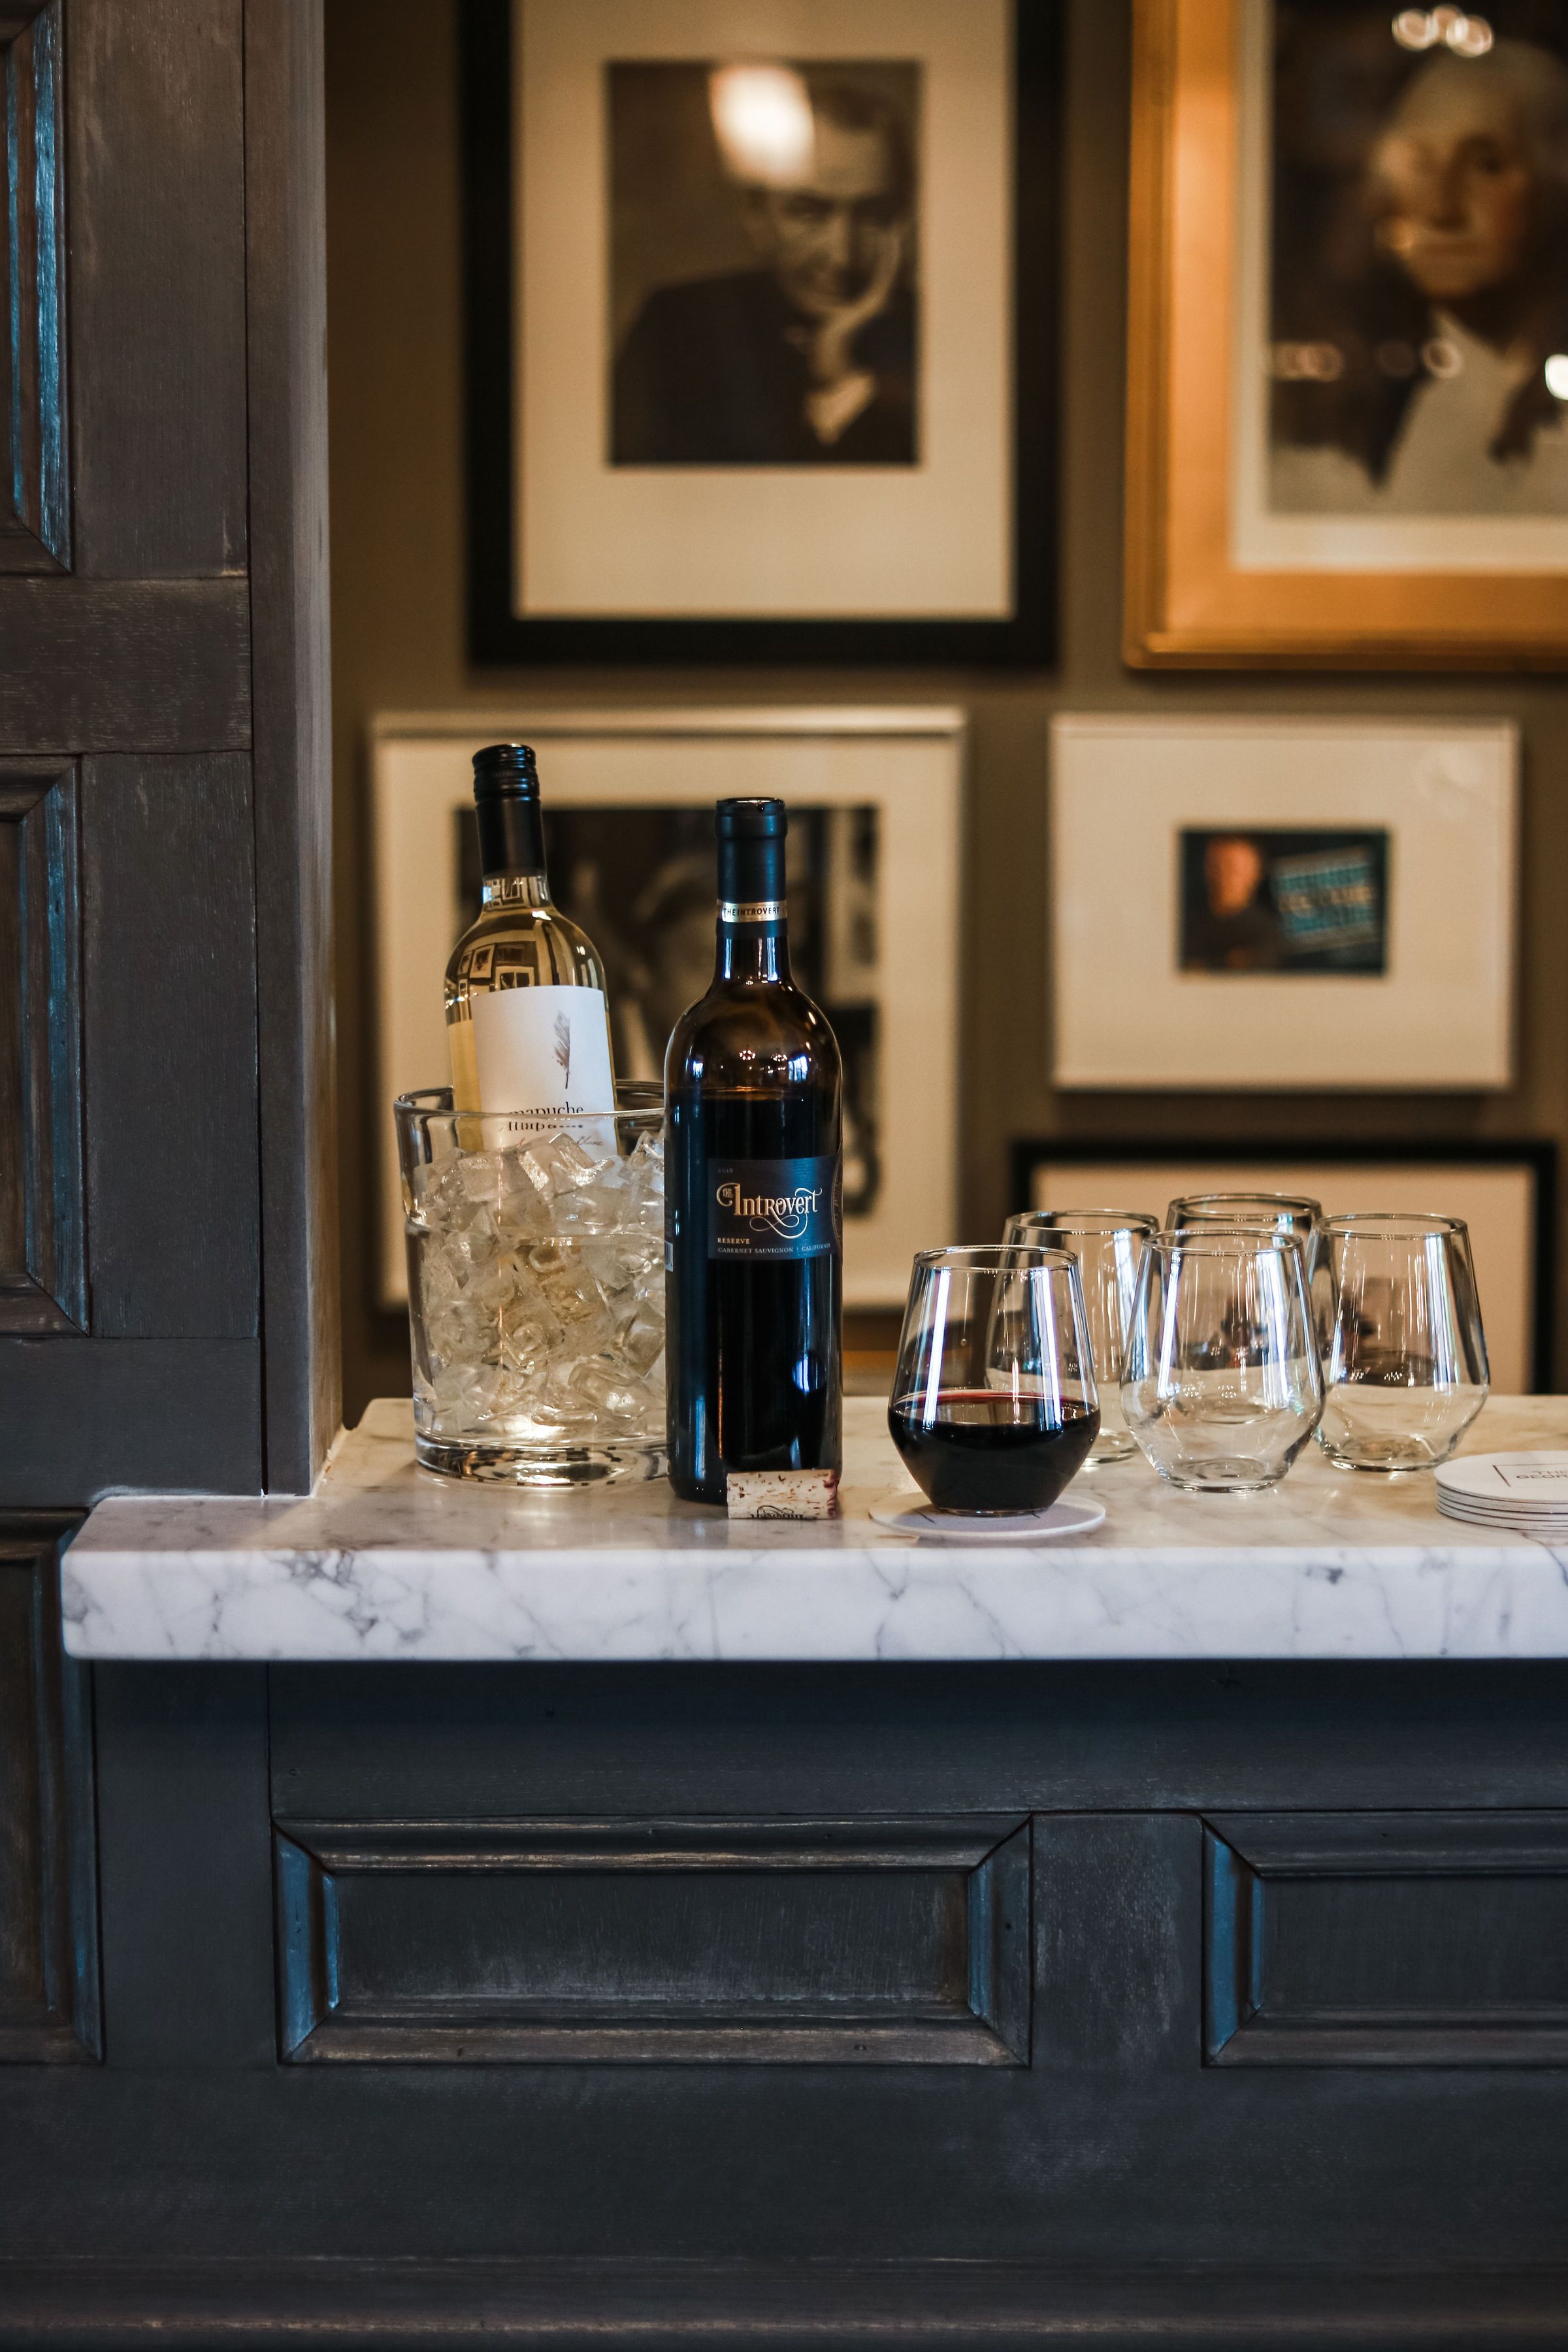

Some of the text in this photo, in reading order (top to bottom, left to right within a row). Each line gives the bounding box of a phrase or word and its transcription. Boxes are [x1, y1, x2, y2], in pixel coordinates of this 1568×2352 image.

[723, 907, 779, 916] THE INTROVERT
[510, 1102, 583, 1115] auche
[722, 1188, 734, 1199] THE
[802, 1243, 830, 1252] CALIFORNIA
